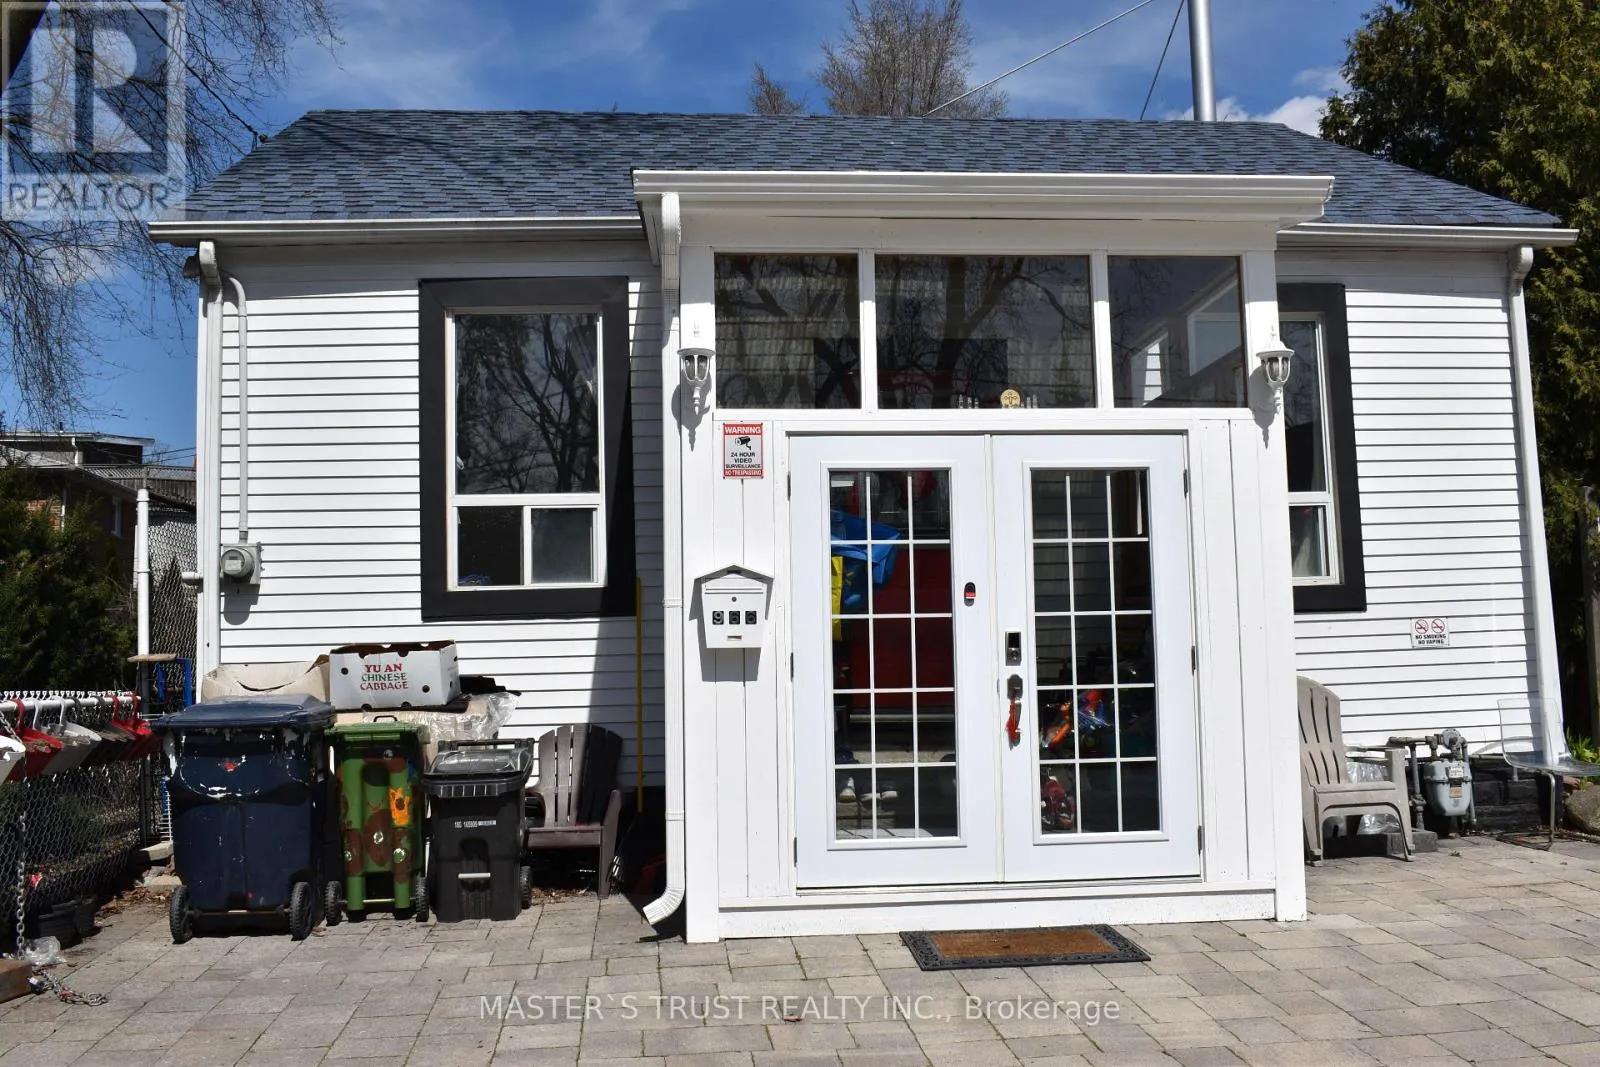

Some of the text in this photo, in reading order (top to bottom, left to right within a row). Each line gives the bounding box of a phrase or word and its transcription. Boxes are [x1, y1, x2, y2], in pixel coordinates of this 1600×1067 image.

[725, 426, 761, 434] WARNING
[364, 663, 402, 673] YU AN
[361, 673, 407, 681] CHINESE
[360, 681, 408, 690] CABBAGE
